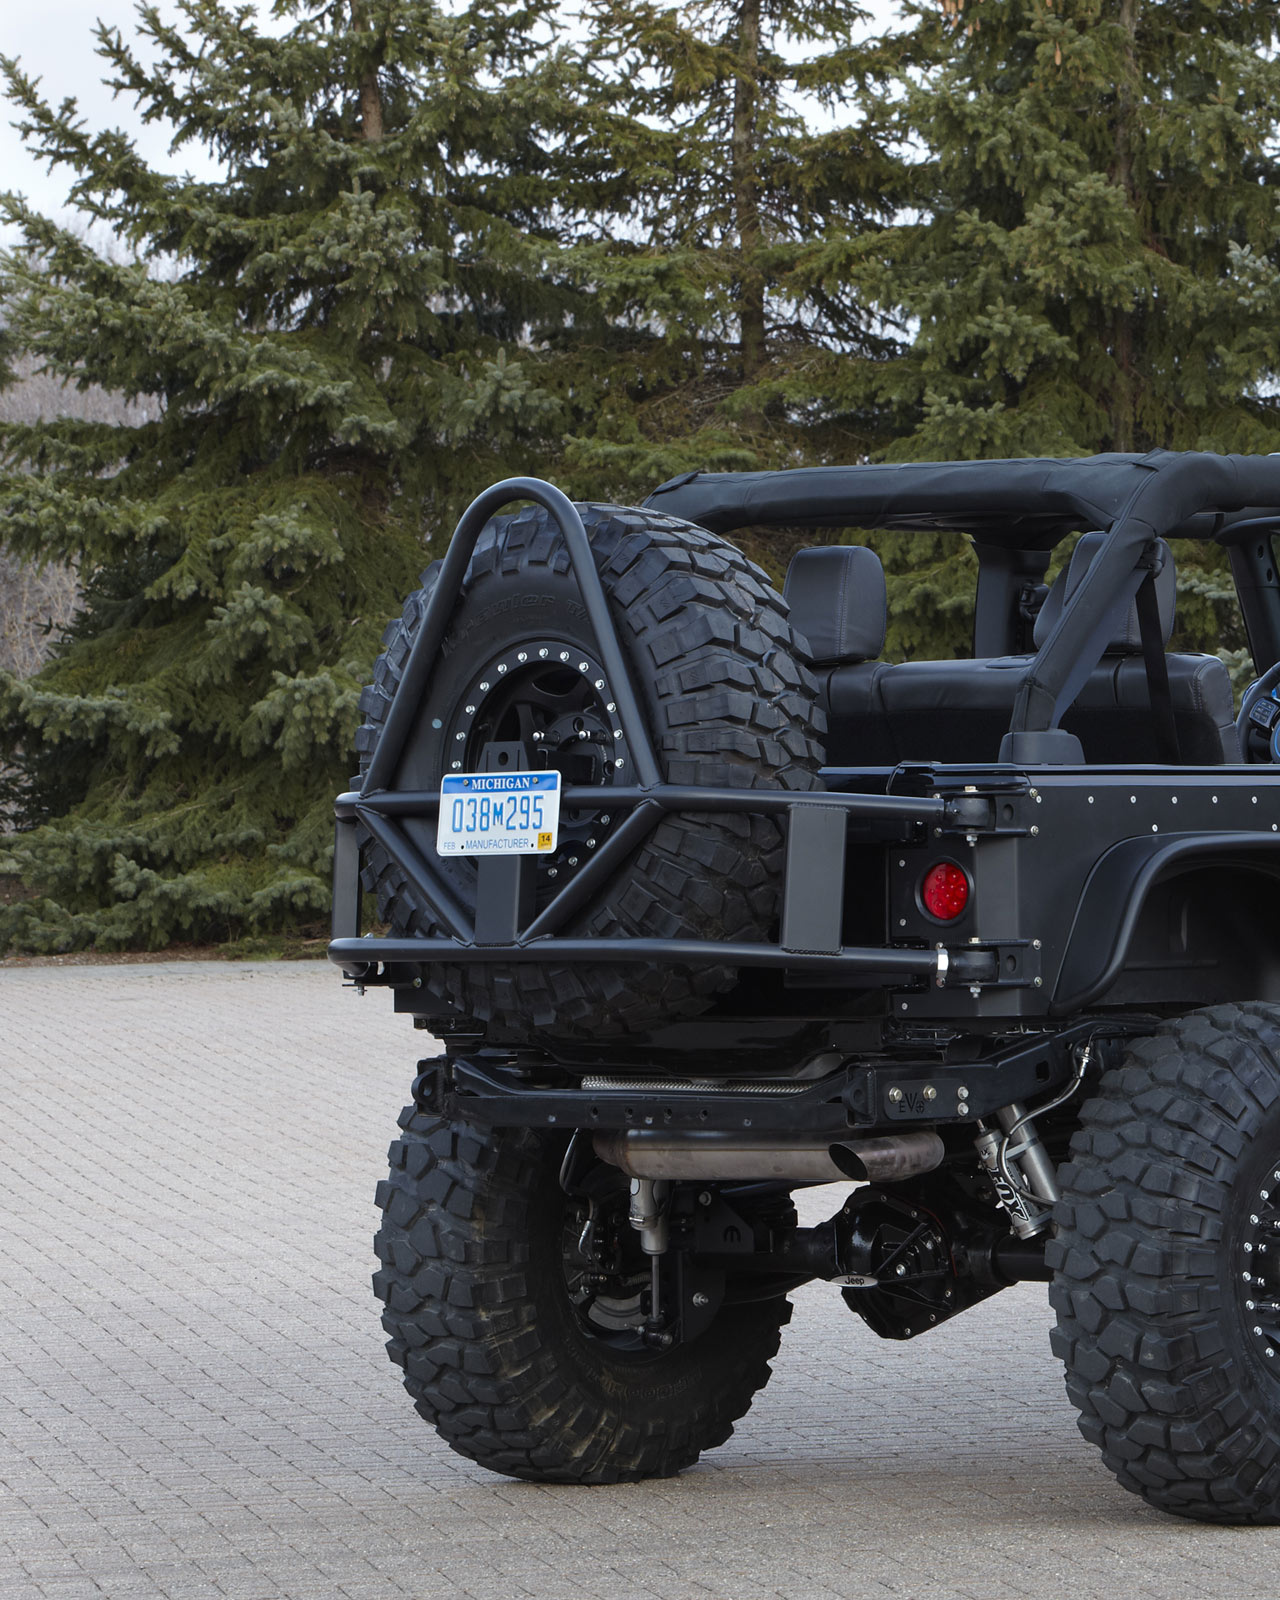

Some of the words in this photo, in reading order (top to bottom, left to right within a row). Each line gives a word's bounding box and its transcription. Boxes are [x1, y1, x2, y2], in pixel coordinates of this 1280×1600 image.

[471, 777, 531, 791] MICHIGAN
[452, 795, 544, 833] 038M295
[443, 841, 456, 850] FEB
[465, 838, 529, 850] MANUFACTURER
[541, 834, 551, 842] 14
[844, 1276, 865, 1287] Jeep
